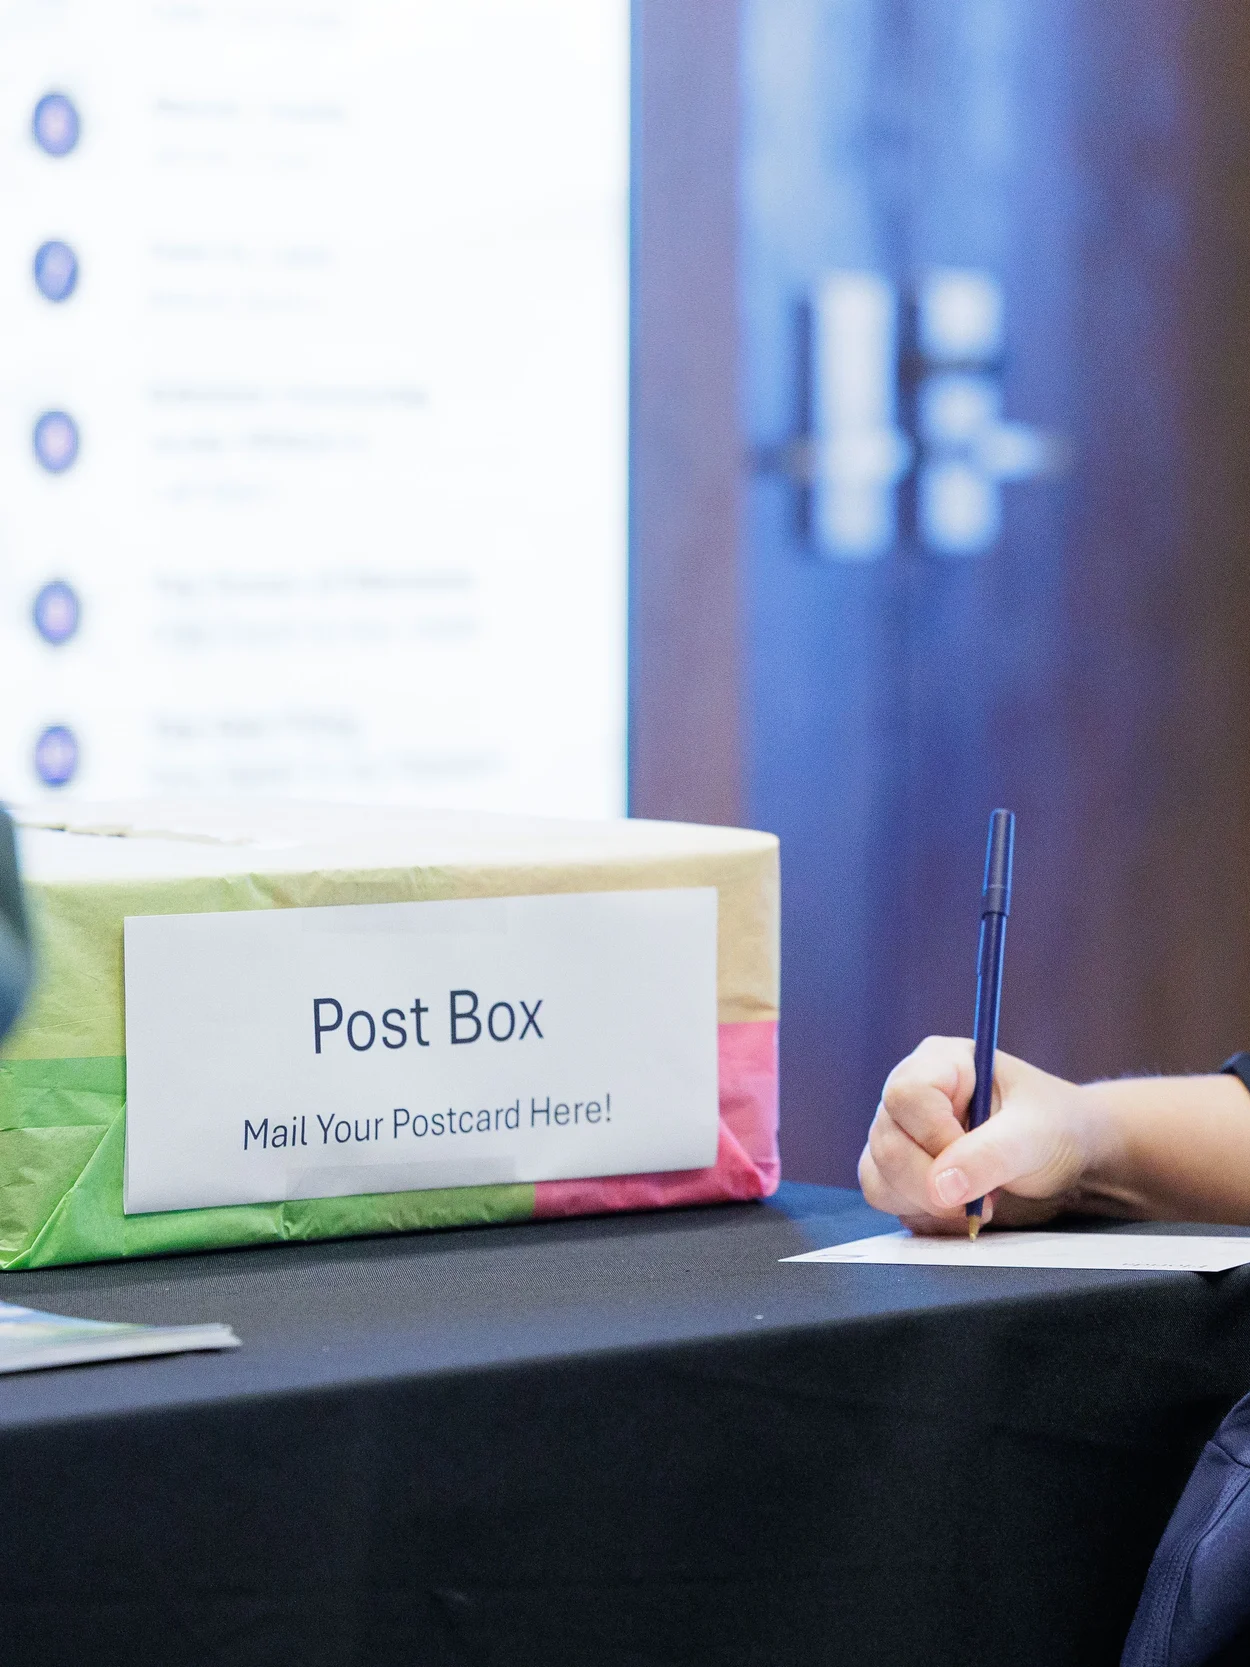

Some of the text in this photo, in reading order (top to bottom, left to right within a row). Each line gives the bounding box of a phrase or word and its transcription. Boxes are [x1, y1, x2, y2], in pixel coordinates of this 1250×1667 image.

[313, 989, 544, 1054] Post Box
[243, 1093, 612, 1151] Mail Your Postcard Here!
